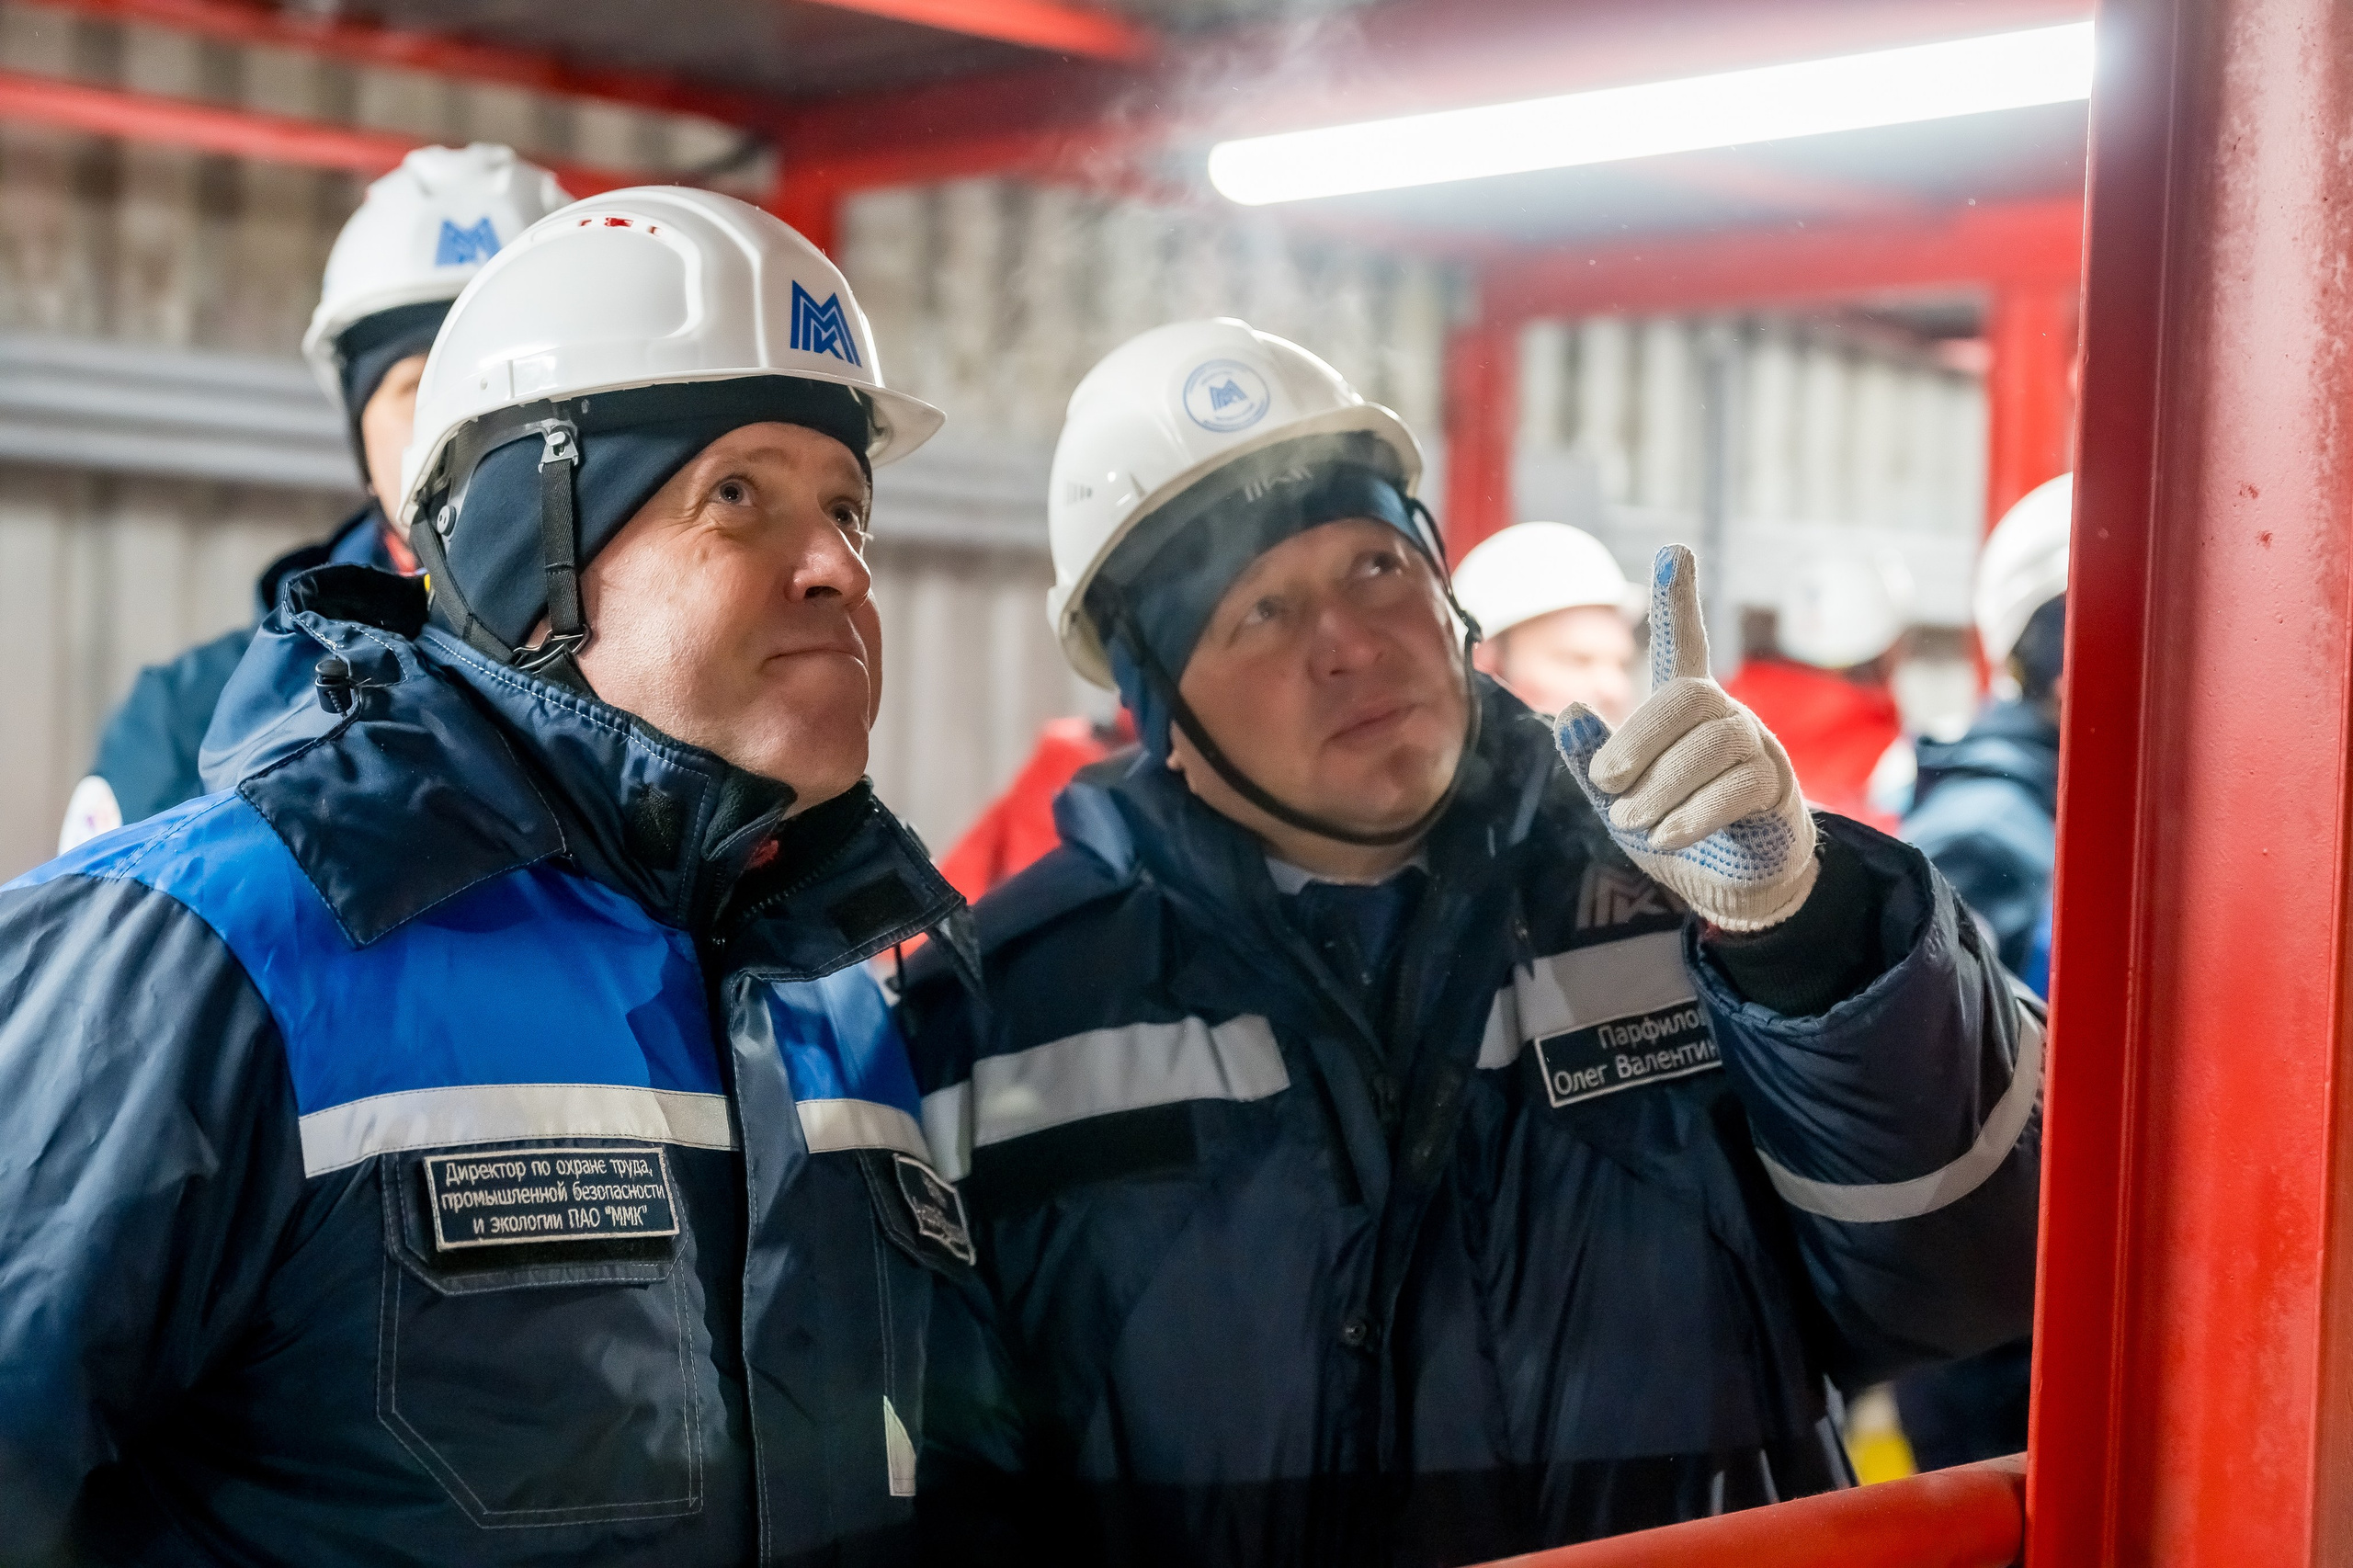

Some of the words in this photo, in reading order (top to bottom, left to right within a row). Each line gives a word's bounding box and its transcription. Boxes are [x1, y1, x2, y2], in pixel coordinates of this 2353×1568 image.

[1553, 1063, 1608, 1096] Олег
[445, 1160, 527, 1187] Директор
[531, 1160, 551, 1176] по
[555, 1158, 608, 1181] охране
[609, 1157, 654, 1180] труда,
[441, 1181, 567, 1213] промышленной
[573, 1182, 665, 1201] безопасности
[472, 1217, 485, 1234] и
[491, 1212, 563, 1233] экологии
[568, 1208, 601, 1228] ПАО
